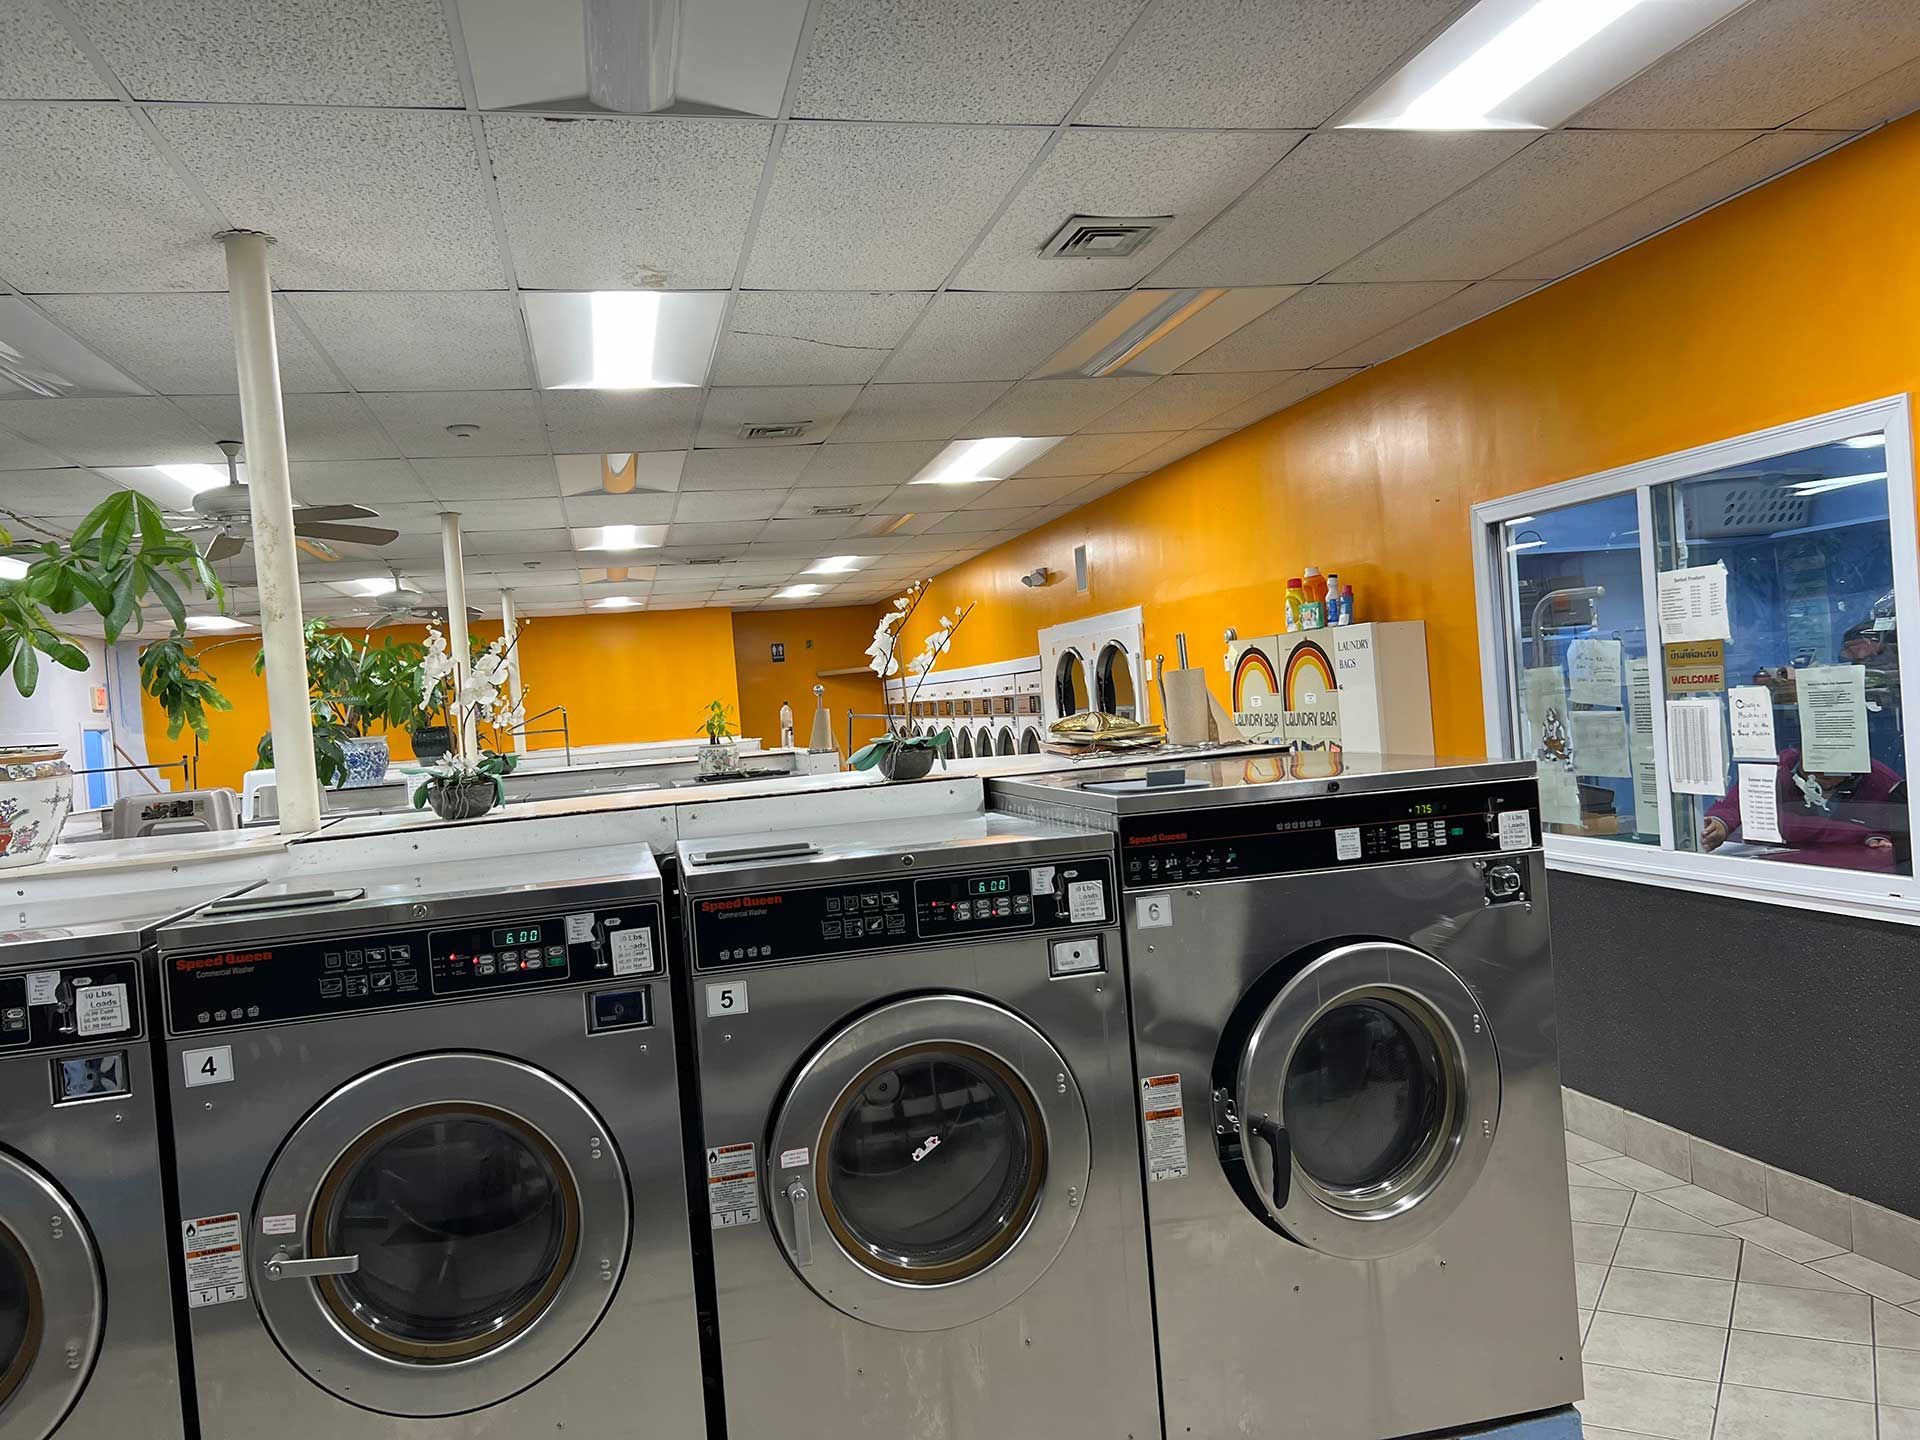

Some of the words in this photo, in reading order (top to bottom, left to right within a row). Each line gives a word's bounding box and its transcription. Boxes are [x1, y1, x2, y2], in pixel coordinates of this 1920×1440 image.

[1337, 638, 1369, 652] LAUNDRY
[1339, 658, 1356, 670] BAGS
[1671, 673, 1720, 685] WELCOME
[1234, 712, 1263, 727] LAUNDRY
[1264, 713, 1279, 727] BAR
[1284, 711, 1318, 727] LAUNDRY
[1320, 711, 1337, 726] BAR
[1129, 834, 1157, 845] Speed
[1159, 832, 1187, 841] Queen
[702, 899, 741, 912] Speed
[743, 895, 782, 907] Queen
[718, 909, 747, 920] Commercial
[749, 908, 767, 917] Washer
[1148, 903, 1160, 921] 6
[176, 953, 224, 971] Speed
[225, 951, 272, 965] Queen
[196, 967, 231, 979] Commercial
[232, 965, 255, 975] Washer
[90, 999, 118, 1008] Loads
[720, 989, 734, 1009] 5
[200, 1055, 217, 1076] 4
